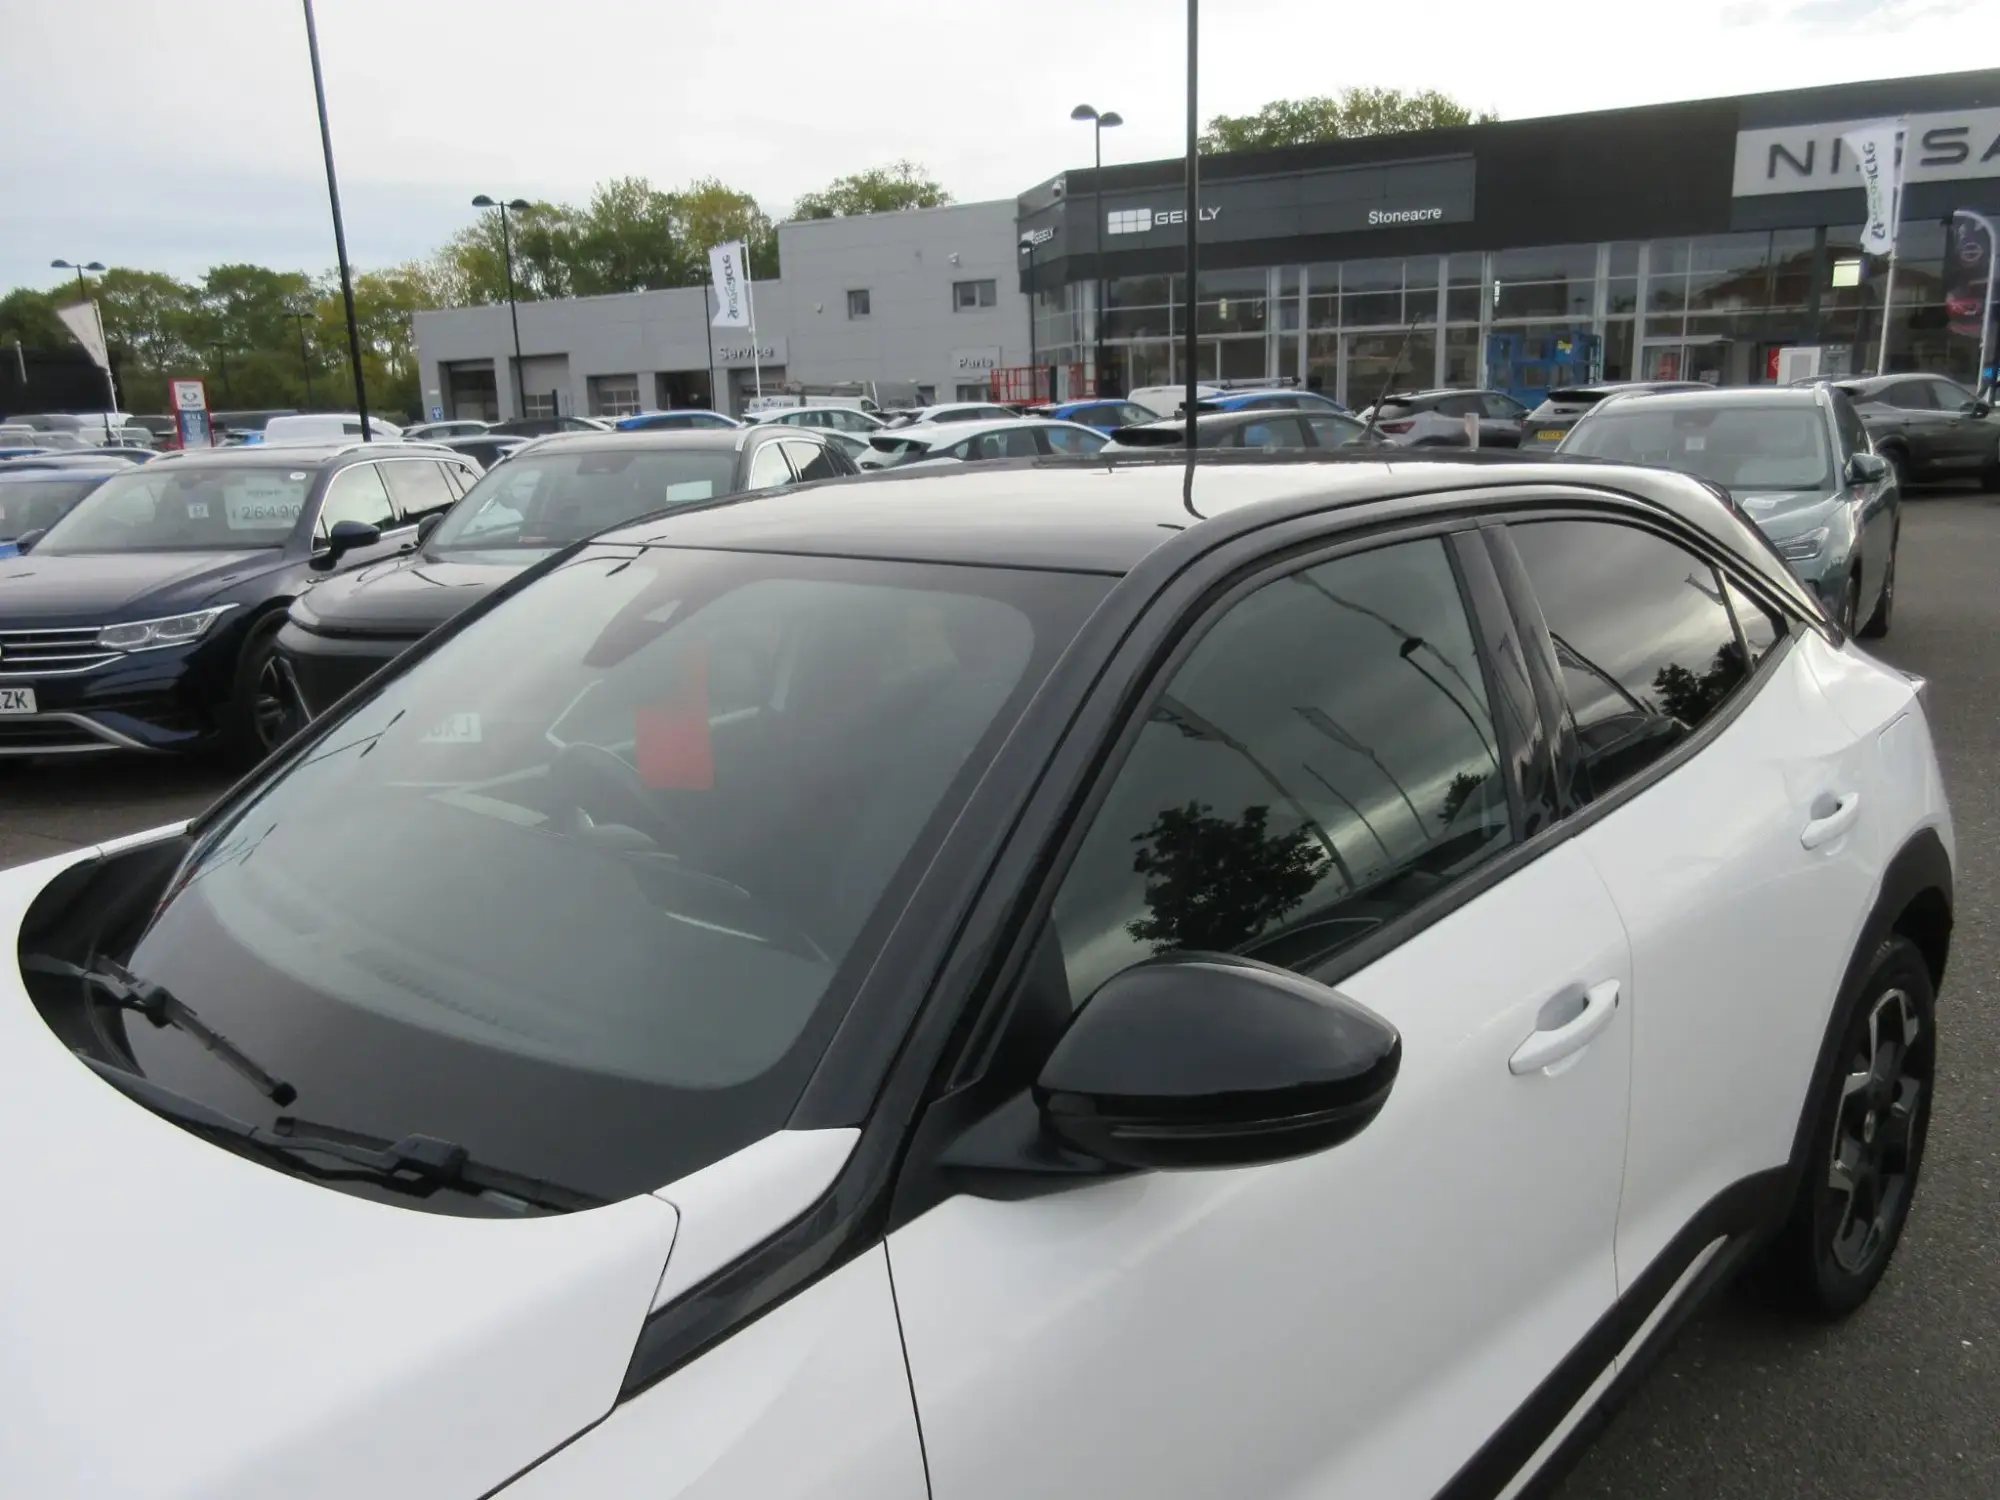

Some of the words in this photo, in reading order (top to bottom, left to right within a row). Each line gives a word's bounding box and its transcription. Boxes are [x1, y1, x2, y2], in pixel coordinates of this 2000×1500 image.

[1767, 125, 2000, 179] NIS
[1155, 206, 1222, 226] GELY
[1368, 207, 1443, 225] Stoneacre
[719, 345, 776, 361] Service
[958, 356, 994, 369] Parts
[0, 690, 29, 709] ZK
